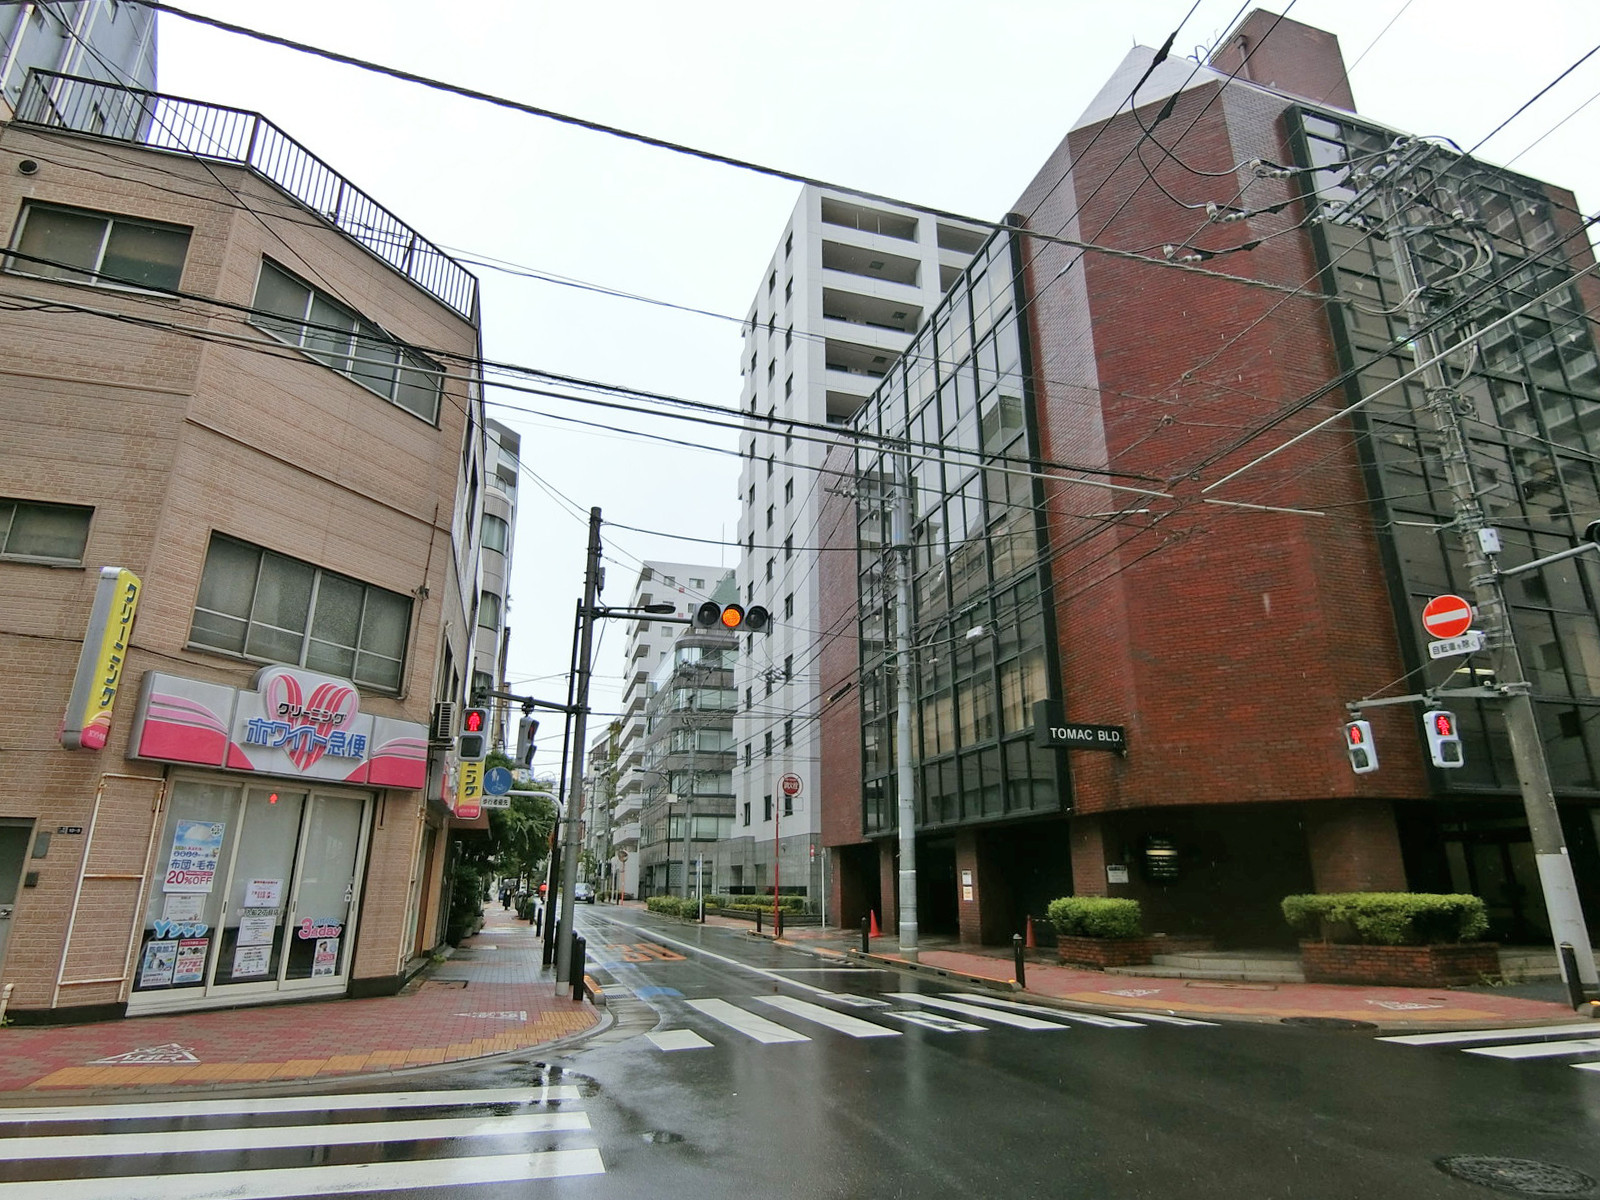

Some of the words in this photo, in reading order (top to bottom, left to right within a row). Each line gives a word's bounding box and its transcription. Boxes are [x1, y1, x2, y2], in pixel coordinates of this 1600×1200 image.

[100, 583, 137, 708] クリーニング
[1432, 639, 1476, 655] 自転車を除く
[278, 702, 347, 724] クリーニング
[246, 717, 367, 759] ホワイト急便
[1050, 727, 1093, 740] TOMAC
[1097, 730, 1123, 742] BLD.
[482, 798, 508, 806] 歩行者優先
[171, 859, 216, 870] 布団・毛布
[154, 919, 208, 938] Yシャツ
